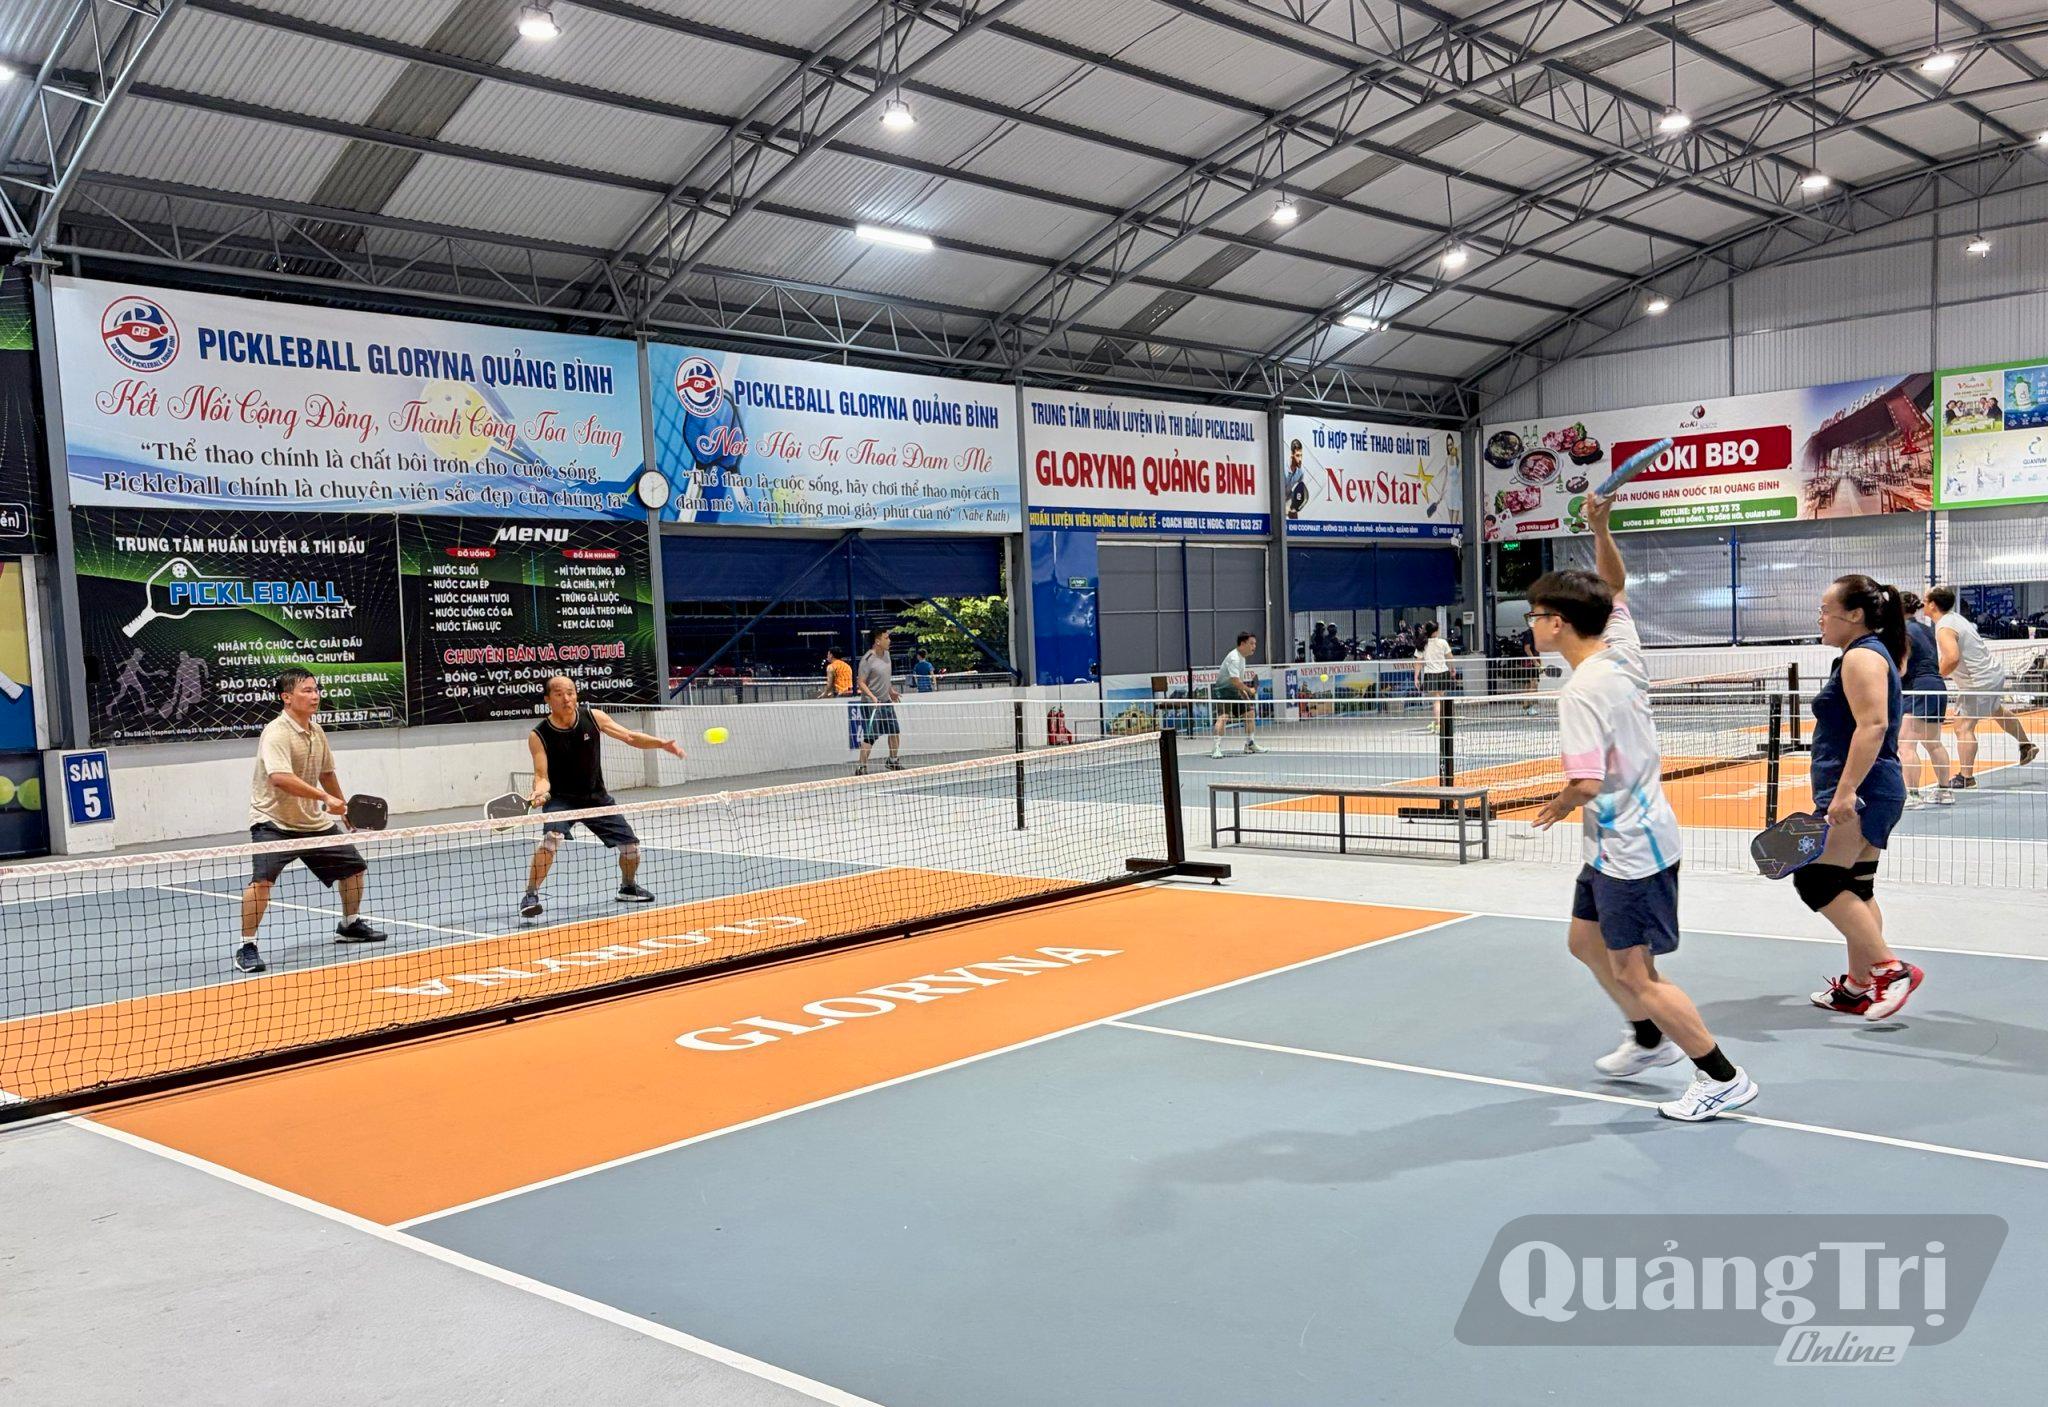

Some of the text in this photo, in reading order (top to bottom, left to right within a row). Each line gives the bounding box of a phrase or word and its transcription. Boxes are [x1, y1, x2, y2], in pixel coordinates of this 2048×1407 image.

[198, 327, 361, 372] PICKLEBALL
[367, 344, 476, 382] GLORYNA
[482, 349, 557, 390] QUẢNG
[563, 359, 614, 395] BÌNH
[734, 380, 835, 414] PICKLEBALL
[839, 390, 909, 422] GLORYNA
[913, 393, 961, 426] QUẢNG
[966, 400, 999, 430] BÌNH
[95, 379, 623, 457] Kết Nối Cộng Đồng, Thành Công Sáng
[1031, 402, 1254, 442] TRUNG TÂM HUẤN LUYỆN VÀ THI ĐẤU PICKLEBALL
[698, 426, 993, 474] Nơi Hội Tụ Đam Mê
[1312, 423, 1414, 456] TỔ HỢP THỂ THAO GIẢI
[205, 445, 601, 484] thao chính là chất bôi trơn cho cuộc sống.
[1641, 439, 1759, 473] OKI BBQ
[1035, 449, 1255, 496] GLORYNA QUẢNG BÌNH
[103, 472, 601, 511] Pickleball chính là chuyên viên sắc đẹp của chúng
[723, 471, 1000, 501] thao là cuộc hãy chơi thể thao cách
[1325, 468, 1422, 505] NewStar
[676, 495, 708, 511] đam
[712, 496, 733, 512] mê
[739, 499, 753, 513] và
[828, 505, 851, 520] mọi
[854, 503, 879, 520] giây
[883, 505, 909, 521] phút
[913, 506, 933, 520] của
[116, 534, 365, 557] TRUNG TÂM HUẤN LUYỆN & THI ĐẤU
[433, 565, 479, 576] NƯỚC SUỐI
[169, 581, 345, 606] PICKLEBALL
[434, 578, 478, 589] NƯỚC CAM
[434, 592, 510, 603] NƯỚC CHANH TƯƠI
[281, 603, 349, 620] NewStar
[435, 606, 514, 617] NƯỚC GA
[562, 607, 616, 615] HOA THEO
[436, 620, 460, 631] NƯỚC
[563, 620, 579, 629] KEM
[218, 636, 362, 656] NHẬN TỔ CHỨC CÁC GIẢI ĐẤU
[444, 641, 625, 664] CHUYÊN VÀ CHO THUÊ
[218, 651, 355, 666] CHUYÊN VÀ KHÔNG CHUYÊN
[220, 677, 244, 690] ĐÀO
[246, 678, 270, 692] TẠO,
[334, 673, 389, 685] PICKLEBALL
[445, 665, 612, 683] BÓNG ĐỒ THỂ THAO
[329, 688, 351, 699] CAO
[445, 679, 633, 699] CÚP, HUY CHƯƠNG CHƯƠNG
[70, 759, 104, 782] SÂN
[83, 787, 102, 818] 5
[674, 942, 1124, 1051] GLORYNA
